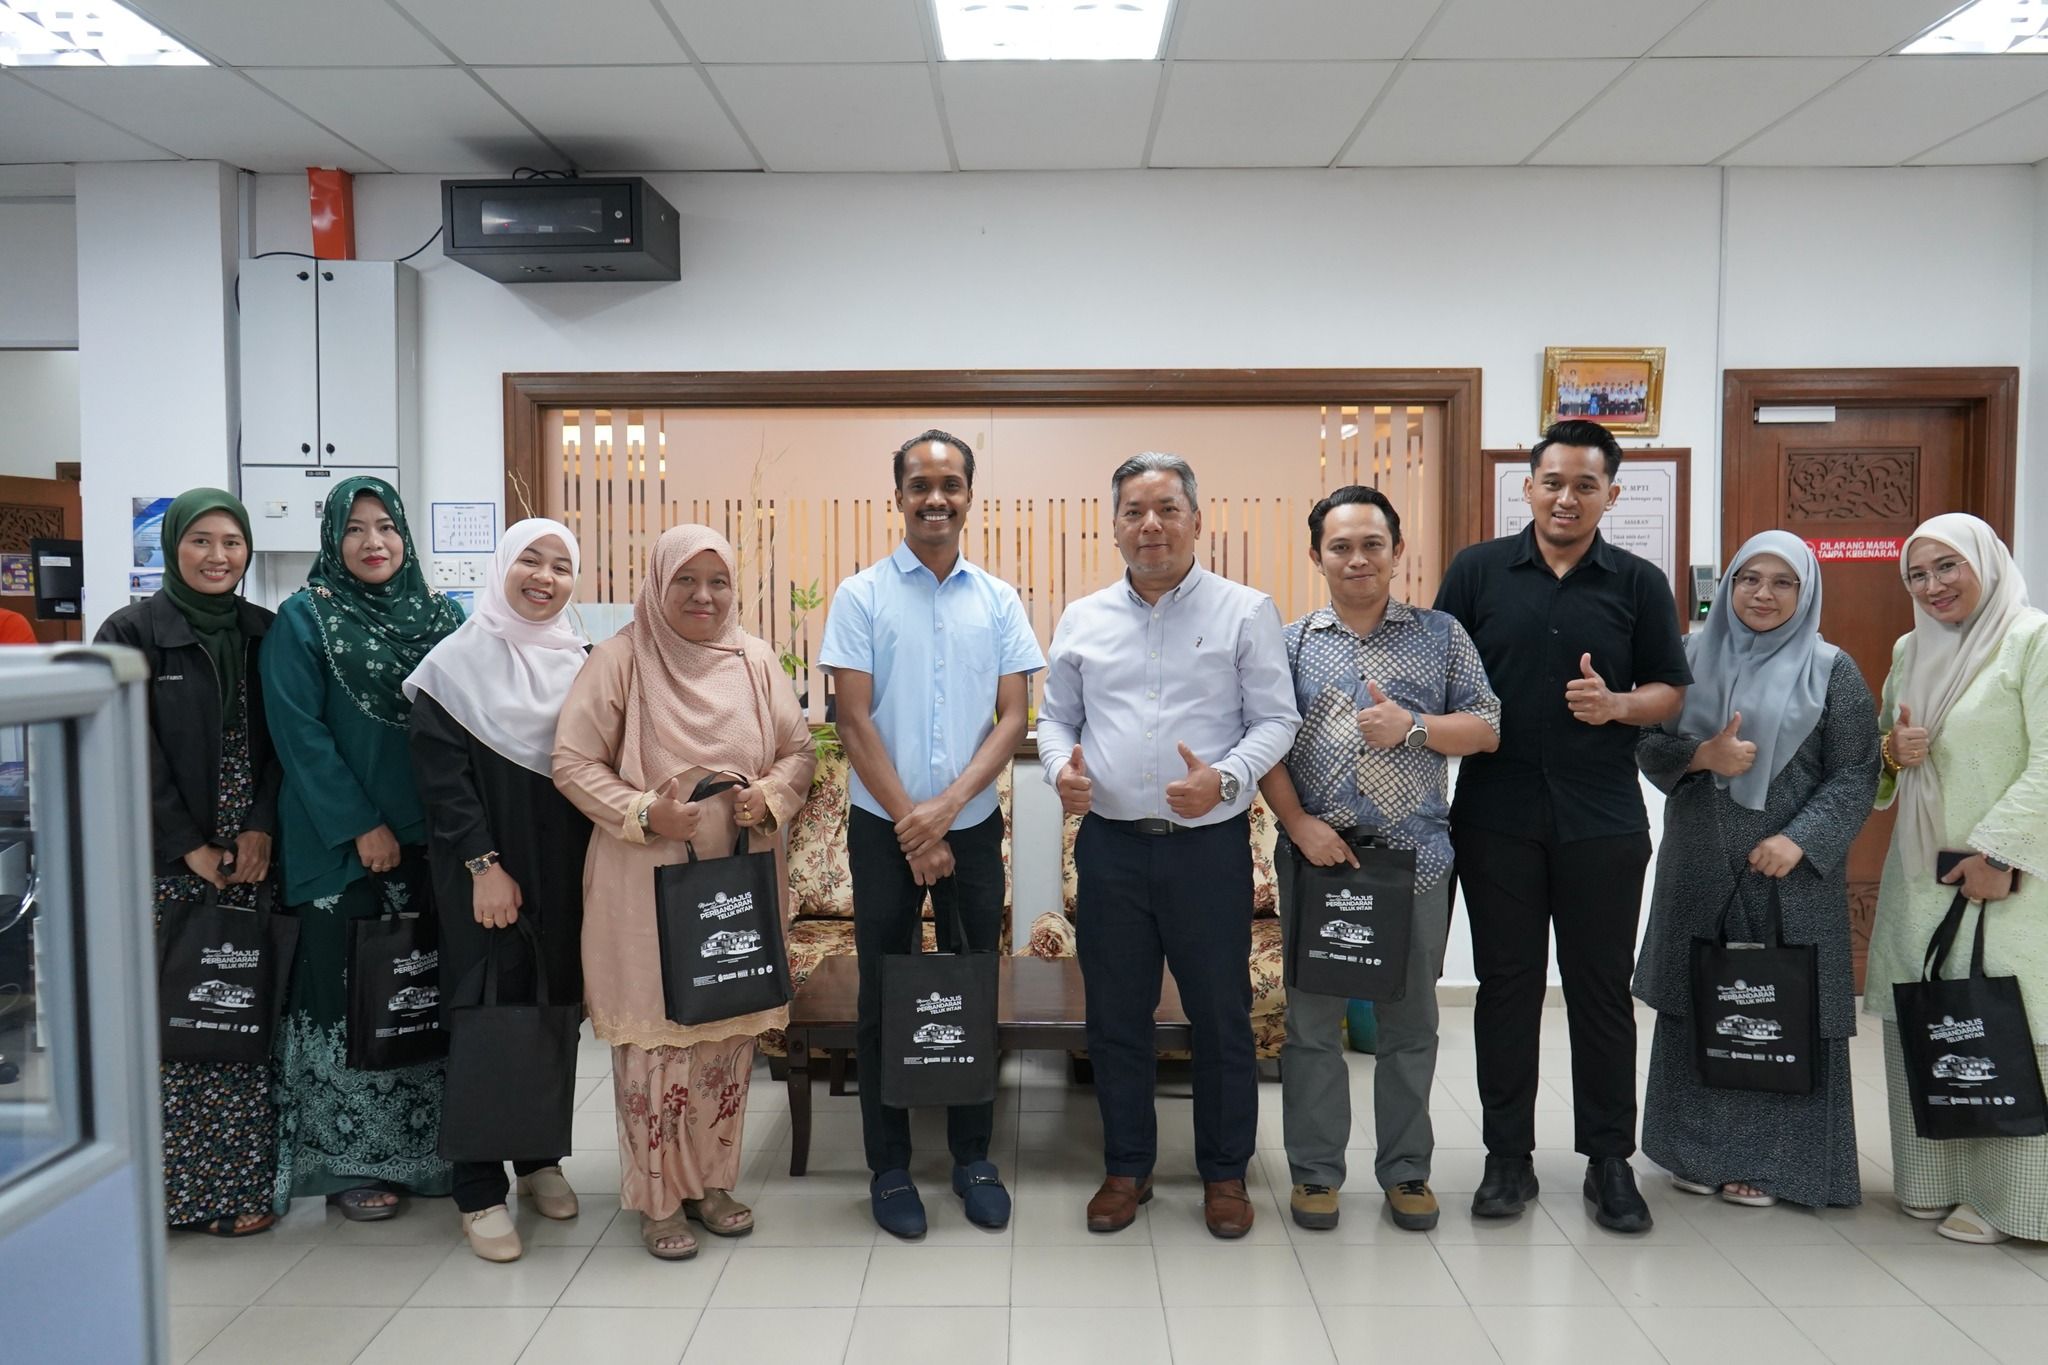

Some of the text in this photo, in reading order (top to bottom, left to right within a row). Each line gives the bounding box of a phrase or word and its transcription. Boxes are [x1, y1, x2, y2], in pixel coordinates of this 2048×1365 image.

[1821, 541, 1896, 550] DILARANG MASUK
[1846, 550, 1899, 558] KEBENARAN
[727, 892, 752, 904] MAJLIS
[700, 899, 752, 920] PERBANDARAN
[717, 911, 735, 920] TELUK
[736, 905, 753, 914] INTAN
[201, 956, 258, 964] PERBANDARAN
[394, 957, 438, 974] PERBANDARAN
[1746, 984, 1775, 992] MAJLIS
[1718, 992, 1775, 1000] PERBANDARAN
[917, 1001, 961, 1012] PERBANDARAN
[1954, 1018, 1983, 1028] MAJLIS
[1930, 1026, 1984, 1040] PERBANDARAN
[1965, 1032, 1984, 1040] INTAN
